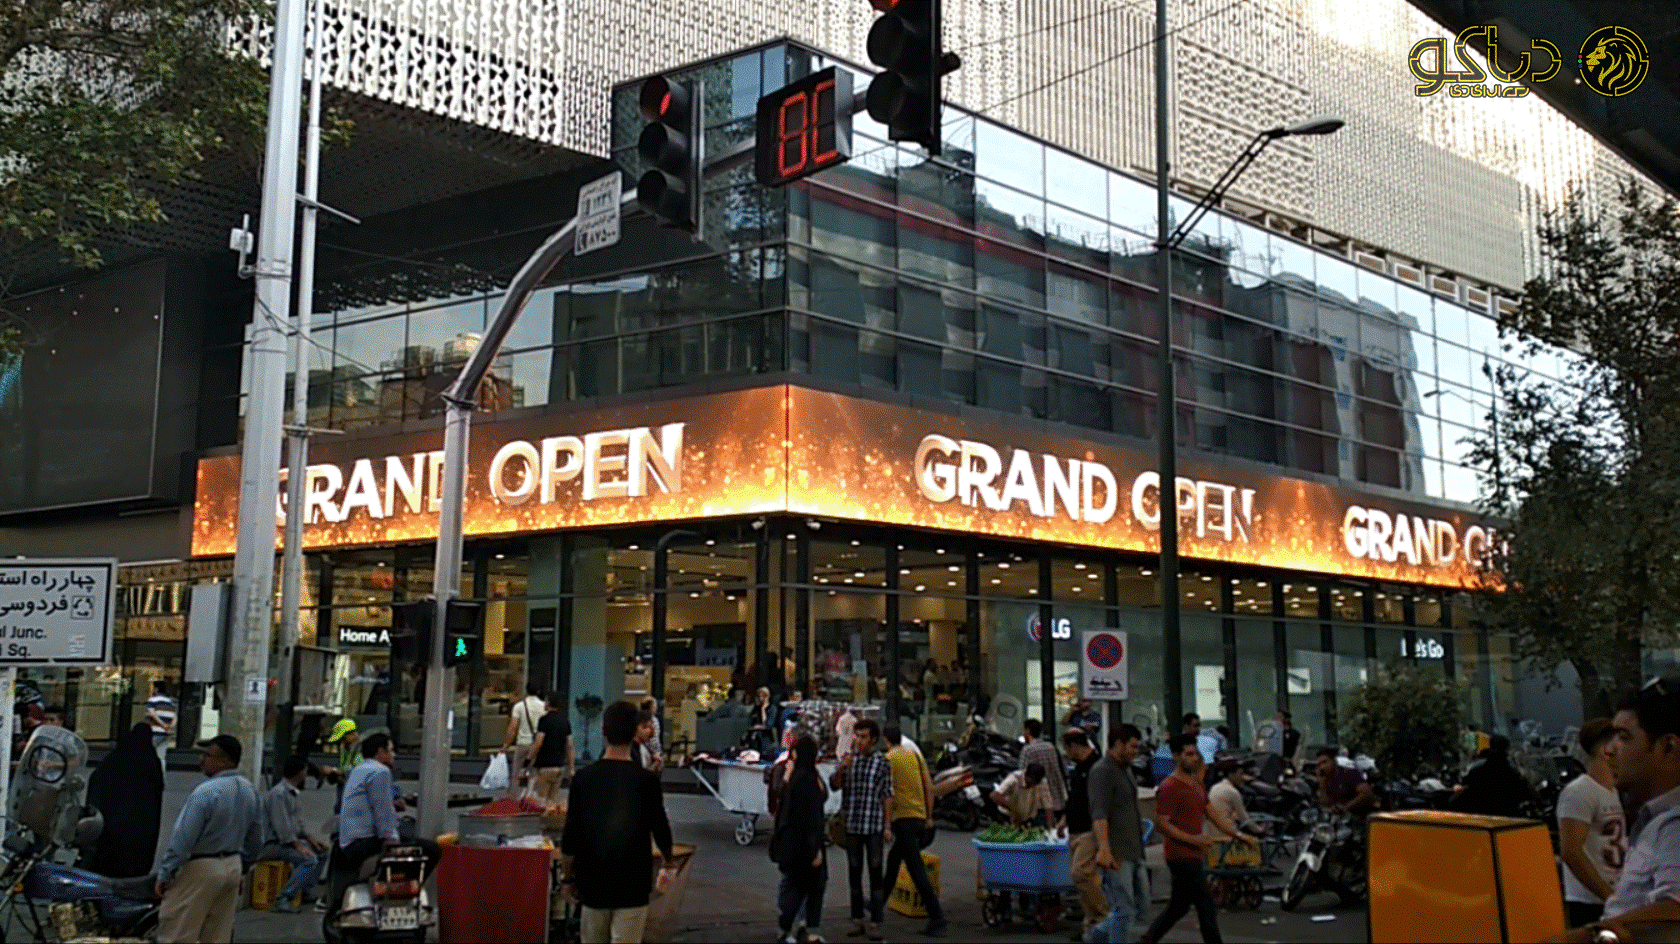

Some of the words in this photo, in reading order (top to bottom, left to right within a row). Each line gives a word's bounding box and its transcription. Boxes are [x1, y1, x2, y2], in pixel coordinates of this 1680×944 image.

[489, 422, 685, 507] OPEN
[914, 434, 1118, 524] GRAND
[1132, 471, 1256, 543] OPEN
[1343, 505, 1458, 567] GRAND
[10, 625, 47, 639] Junc.
[340, 628, 377, 643] Home
[379, 629, 391, 643] A
[1051, 618, 1071, 639] LG
[8, 643, 31, 659] Sq.
[1428, 638, 1445, 658] Go
